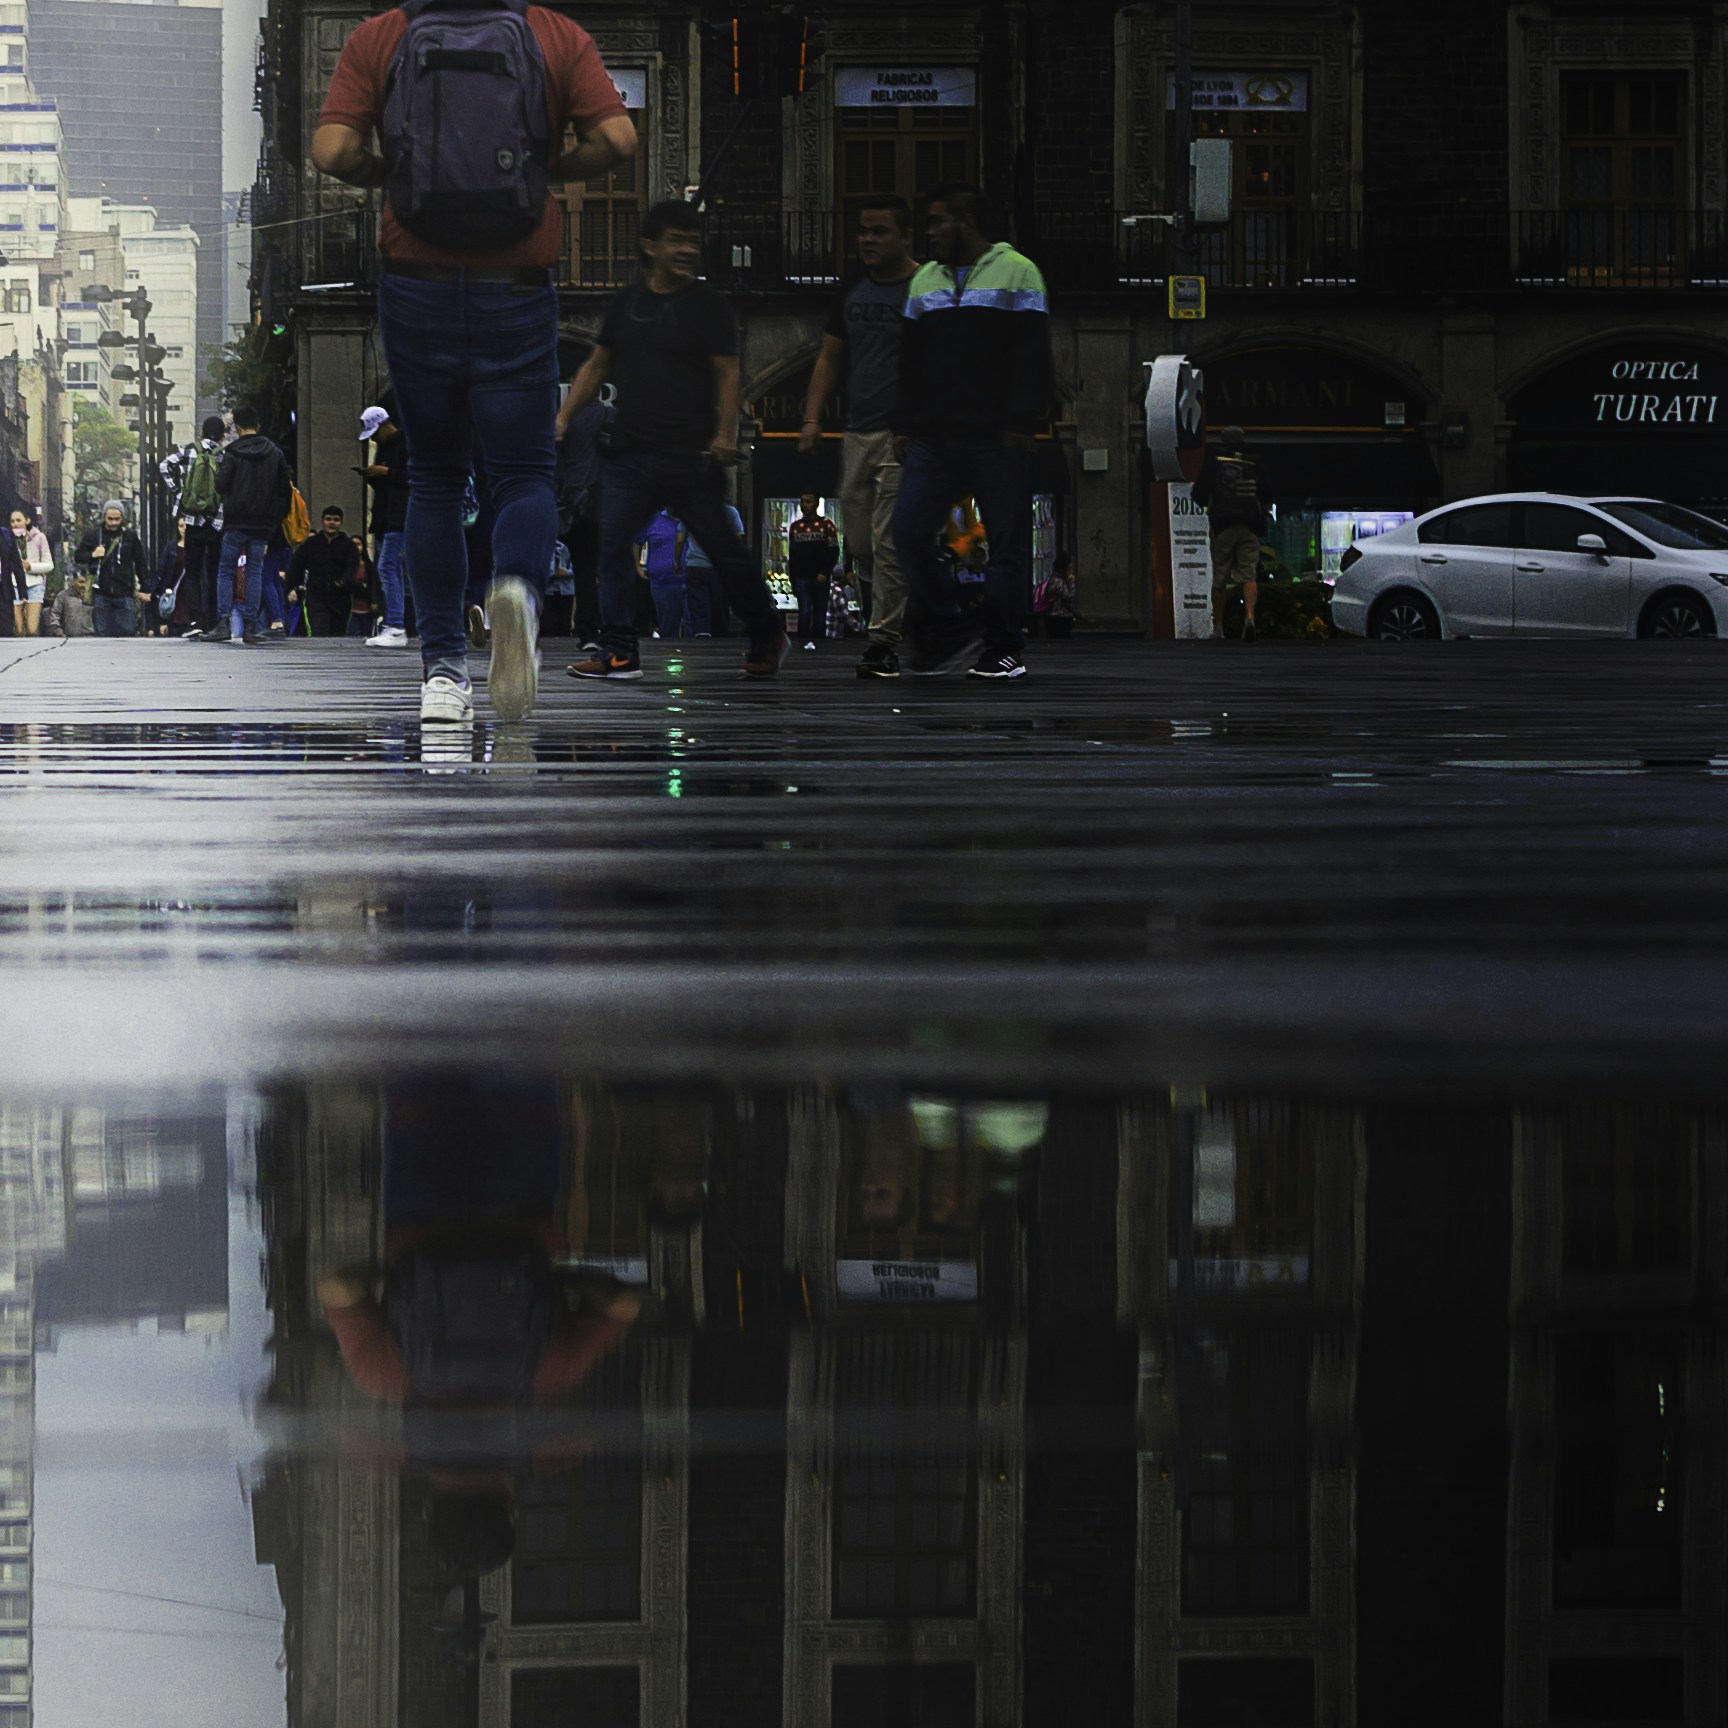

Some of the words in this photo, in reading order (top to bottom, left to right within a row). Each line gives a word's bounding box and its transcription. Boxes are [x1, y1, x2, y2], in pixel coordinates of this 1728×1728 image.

[877, 72, 934, 85] FABRICAS
[871, 89, 939, 102] RELIGIOSOS
[1611, 360, 1700, 381] OPTICA
[1593, 393, 1718, 424] TURATI
